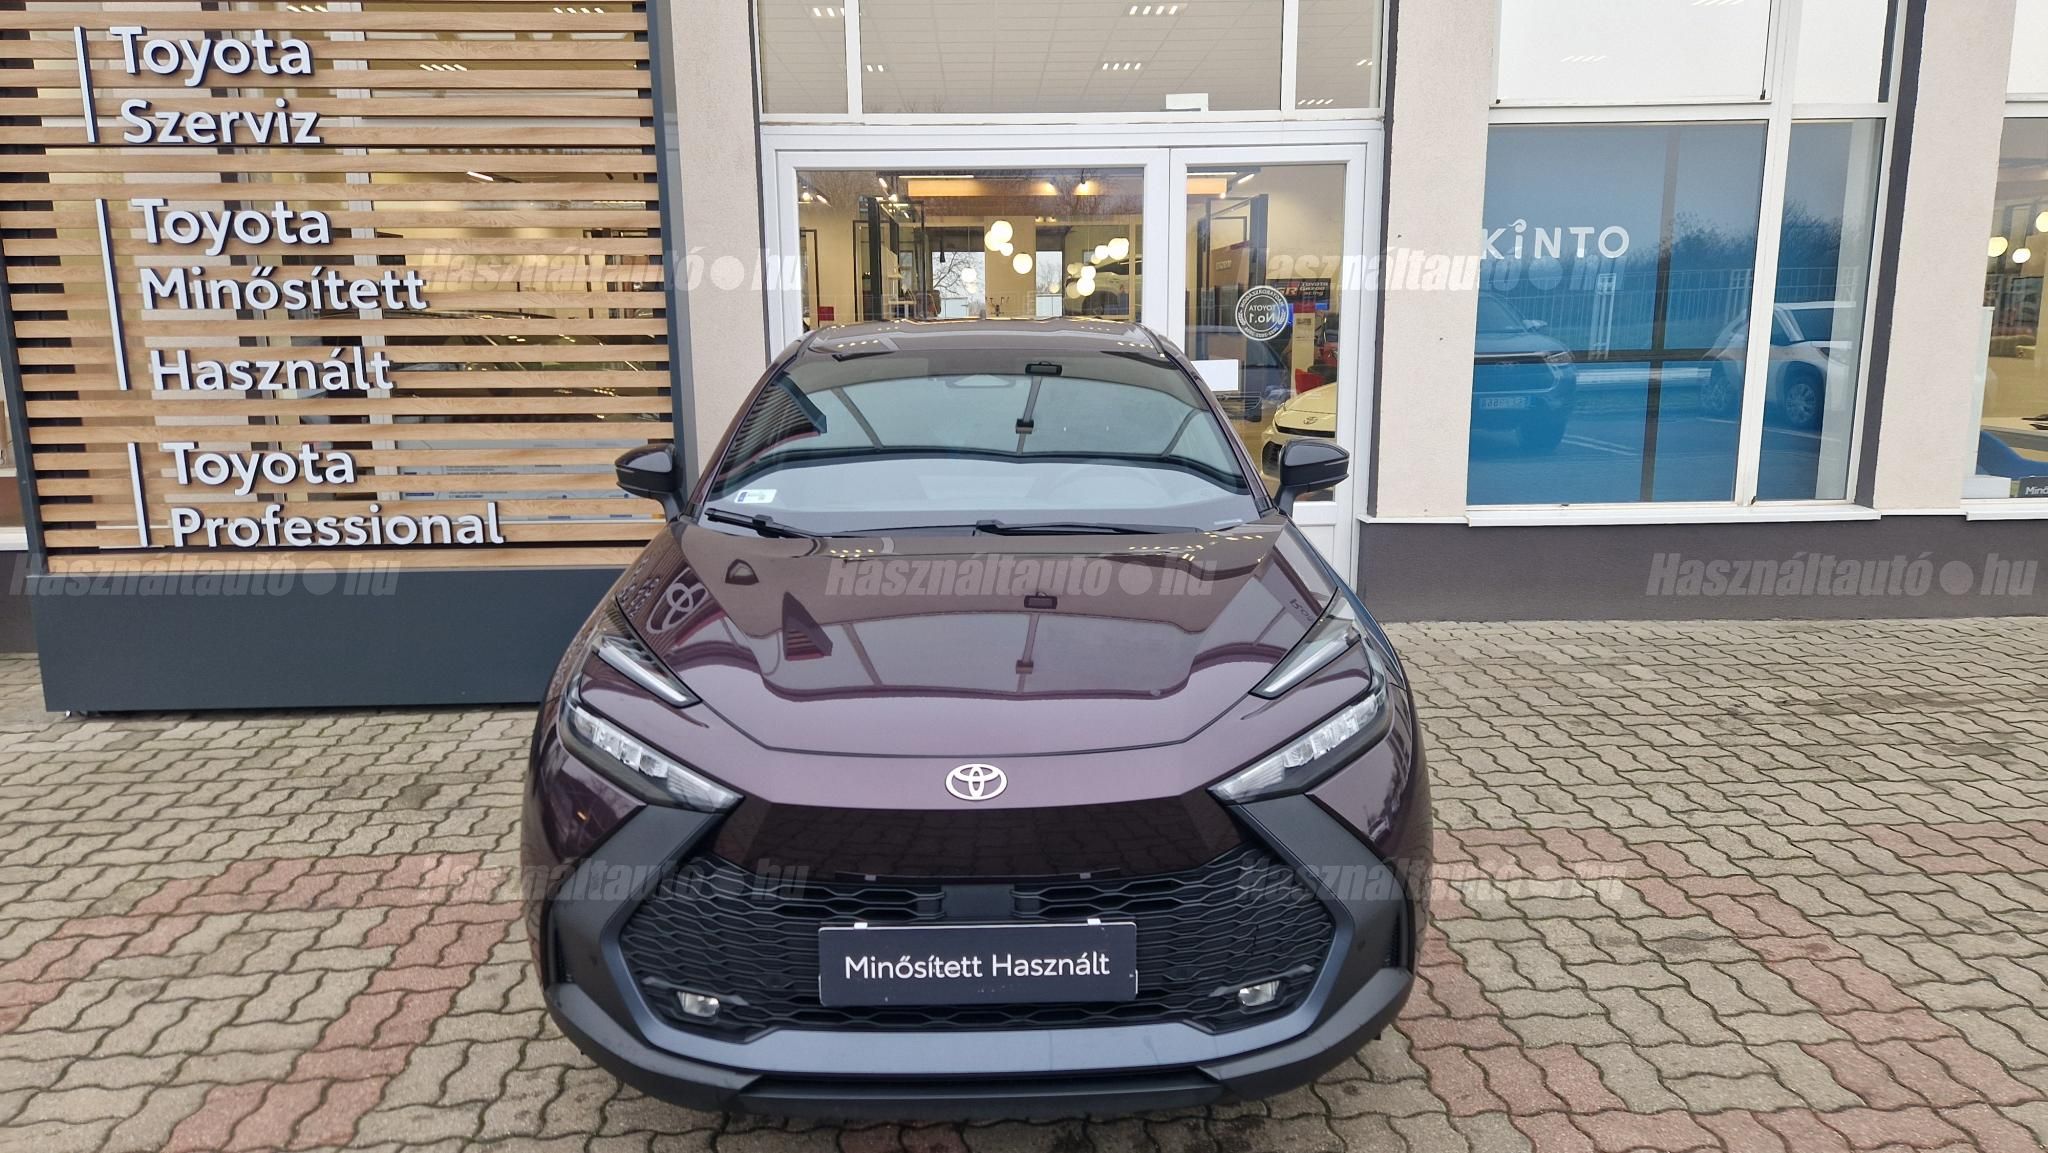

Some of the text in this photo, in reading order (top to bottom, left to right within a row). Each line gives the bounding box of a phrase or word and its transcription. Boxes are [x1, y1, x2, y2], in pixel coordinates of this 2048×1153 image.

[110, 26, 313, 87] Toyota
[119, 98, 322, 145] Szerviz
[131, 198, 332, 256] Toyota
[139, 266, 427, 313] Minősített
[150, 347, 395, 392] Használt
[162, 442, 357, 497] Toyota
[170, 502, 504, 548] Professional
[845, 950, 1110, 980] Minősített Használt
